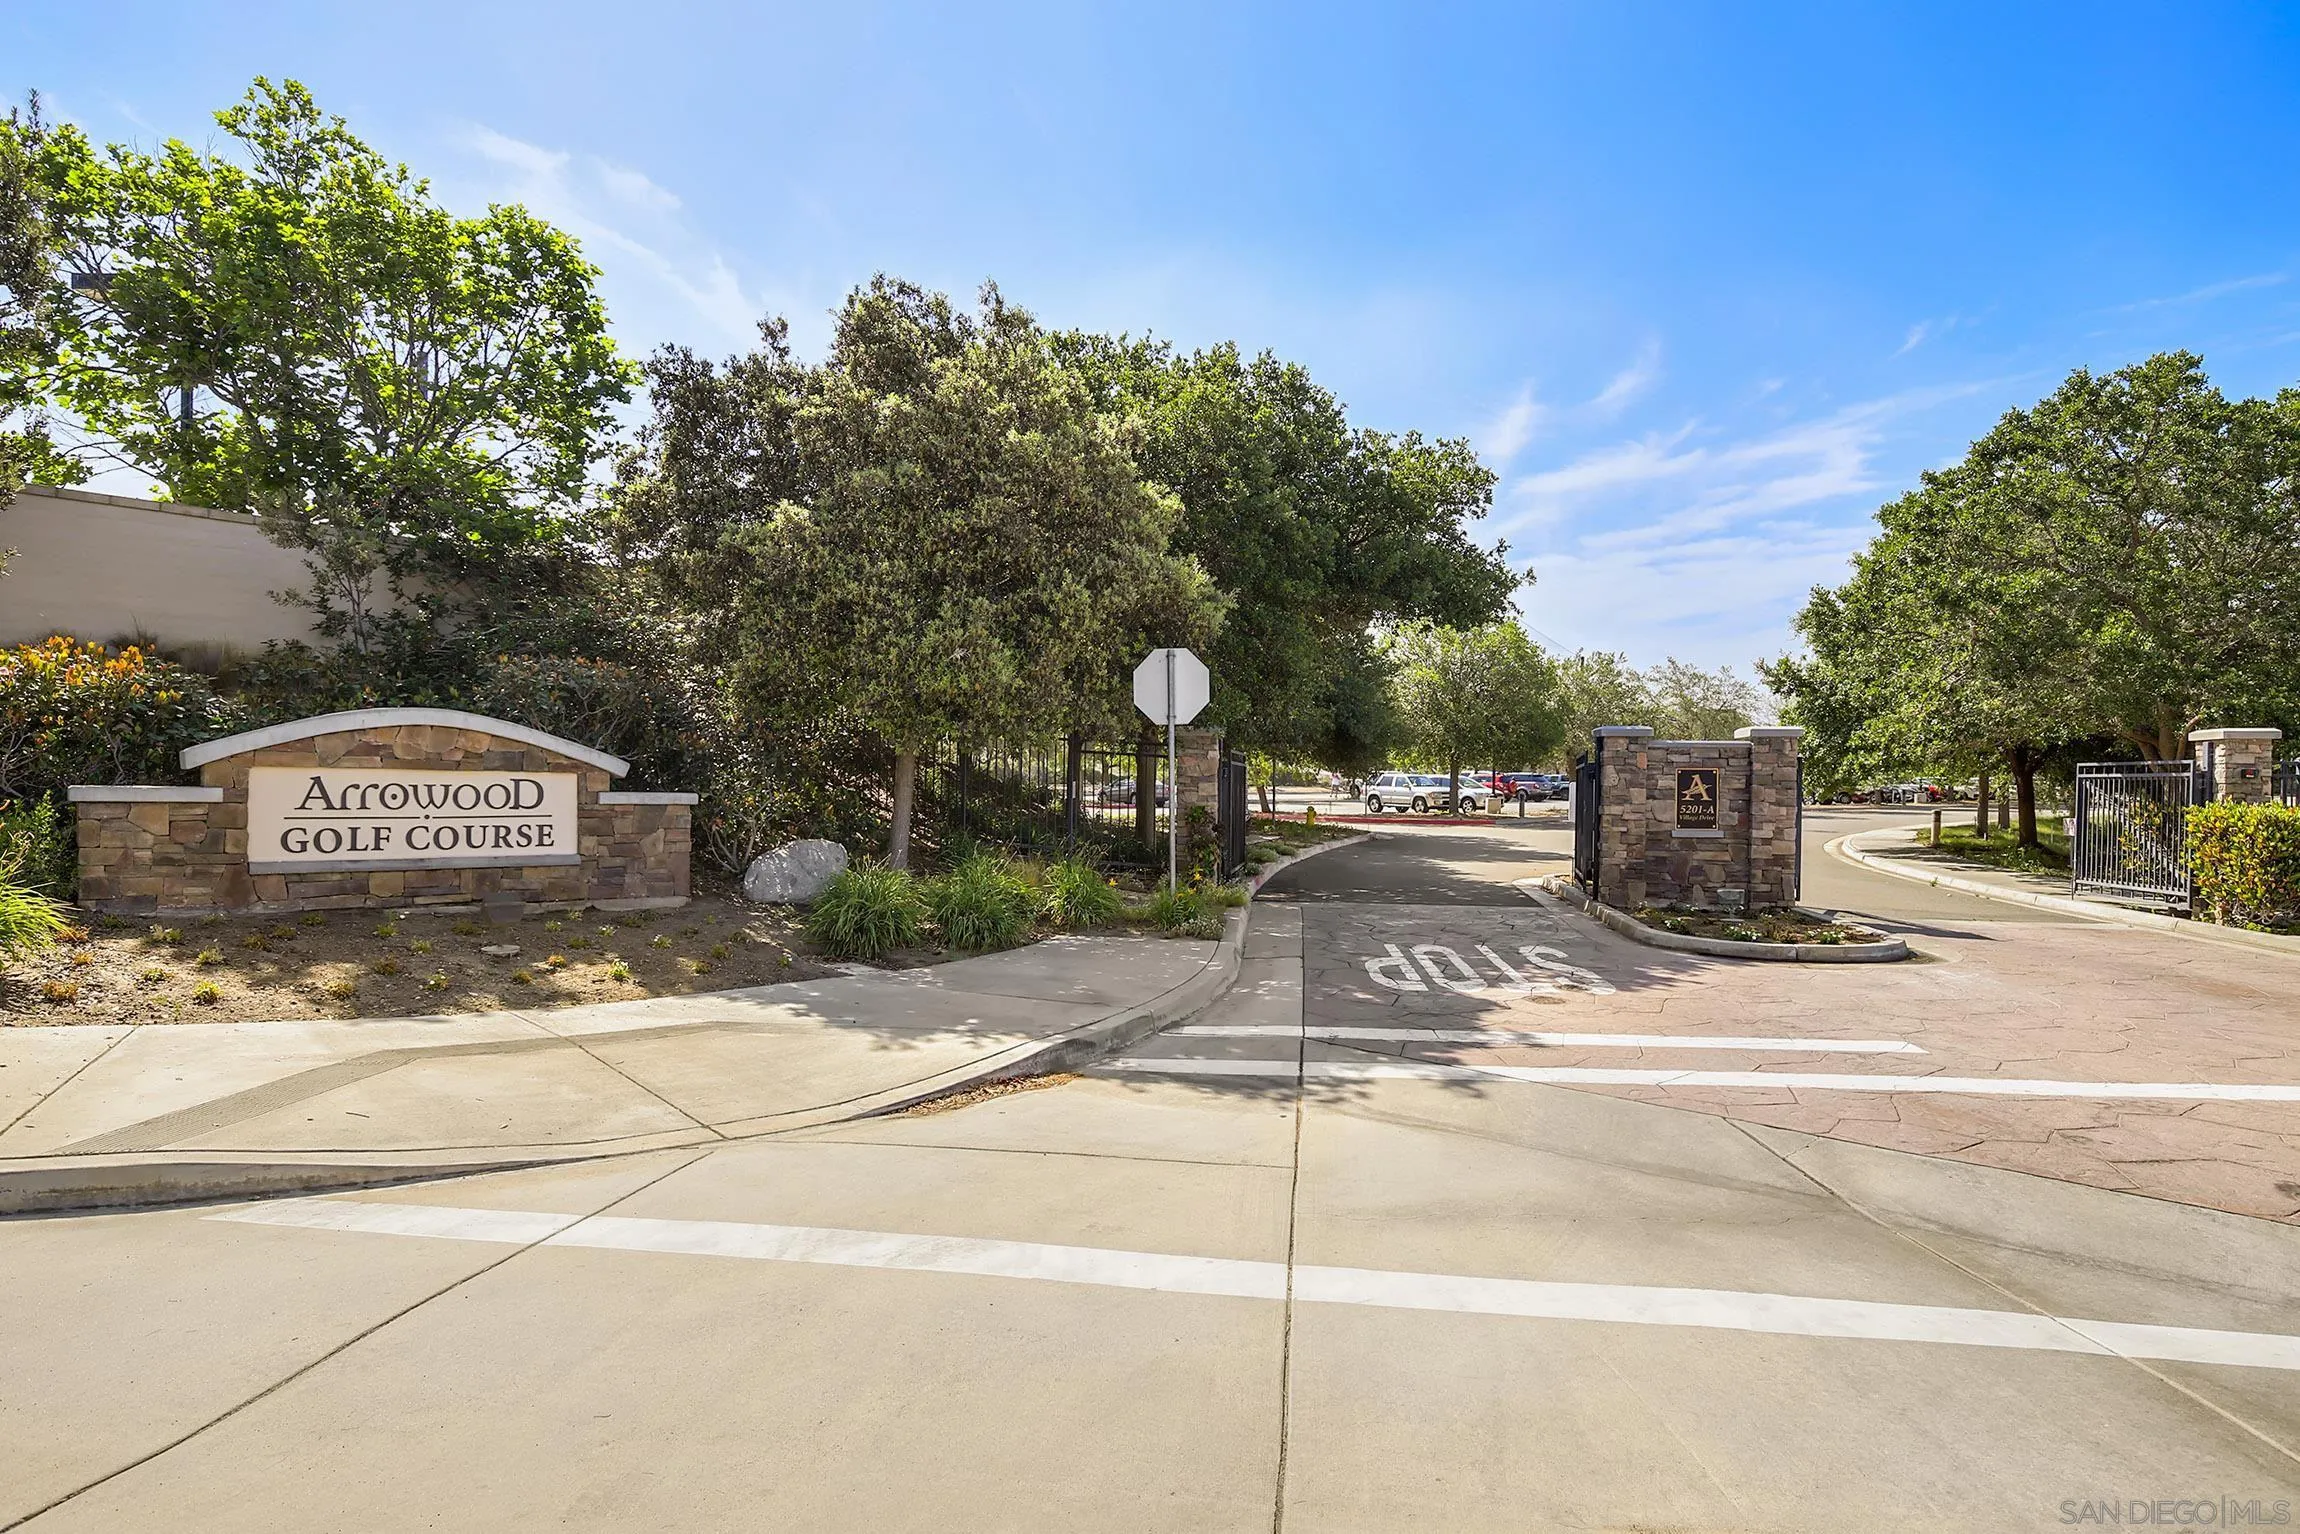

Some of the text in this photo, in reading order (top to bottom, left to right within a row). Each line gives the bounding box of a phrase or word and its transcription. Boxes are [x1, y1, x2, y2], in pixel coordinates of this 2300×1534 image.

[1681, 774, 1713, 801] A
[1680, 805, 1714, 814] 5201-A
[280, 824, 555, 854] GOLF COURSE
[1364, 943, 1616, 995] STOP
